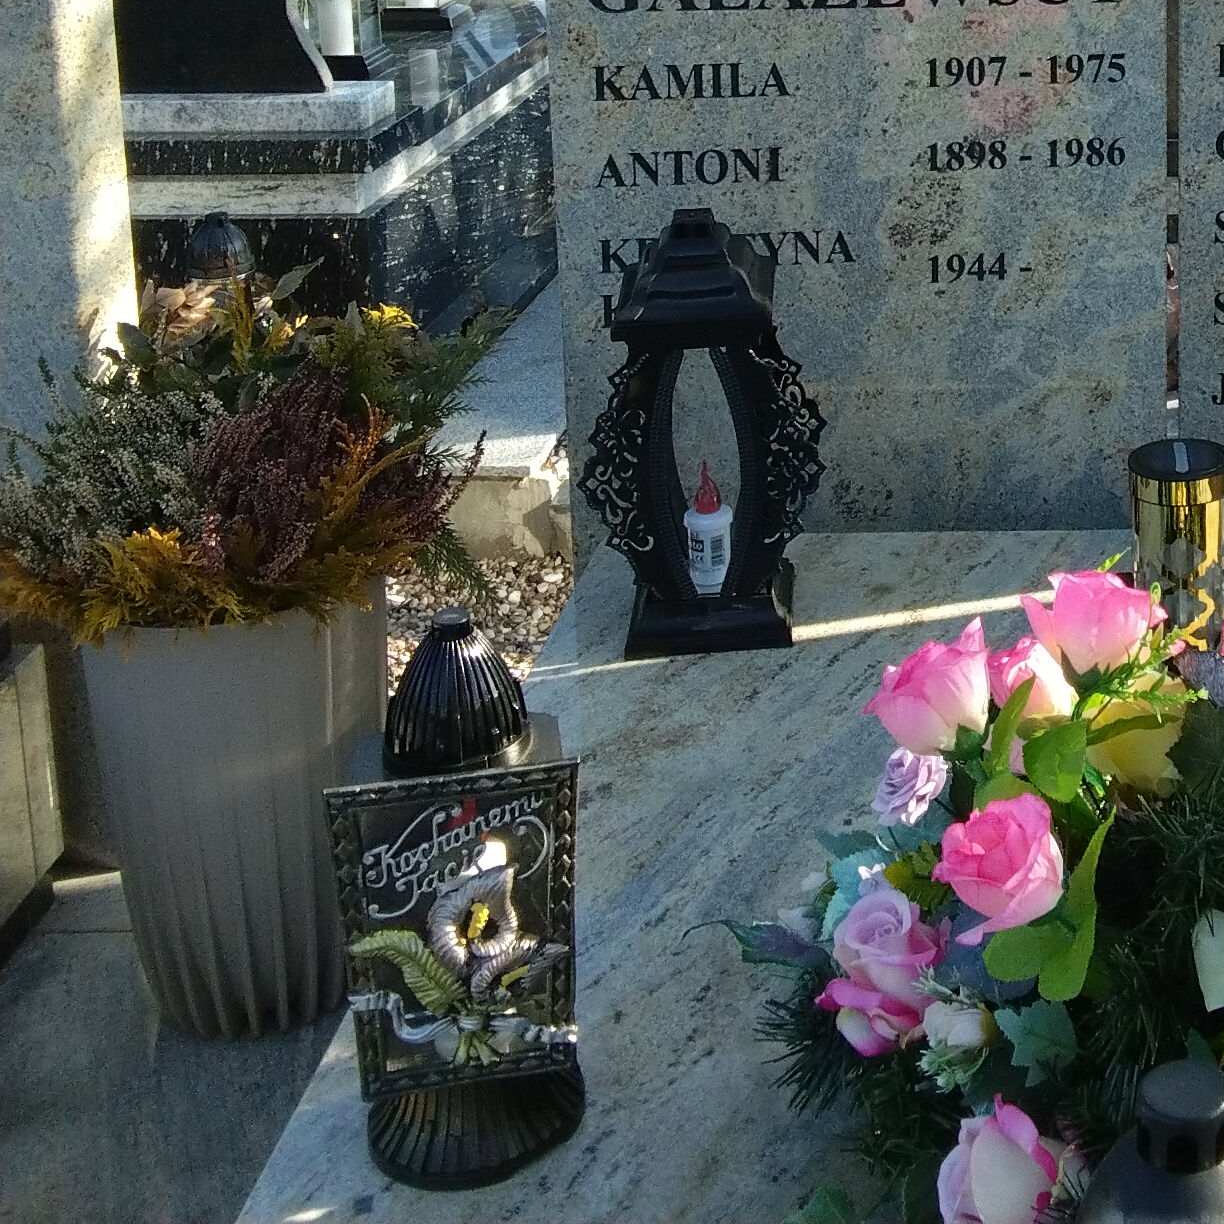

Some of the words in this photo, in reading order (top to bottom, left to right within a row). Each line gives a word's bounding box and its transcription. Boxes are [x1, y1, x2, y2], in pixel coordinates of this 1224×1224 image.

[593, 62, 792, 103] KAMILA
[927, 56, 1008, 89] 1907
[1046, 53, 1128, 86] 1975
[595, 147, 786, 189] ANTONI
[927, 139, 1008, 173] 1898
[1046, 136, 1128, 169] 1986
[928, 252, 1008, 284] 1944
